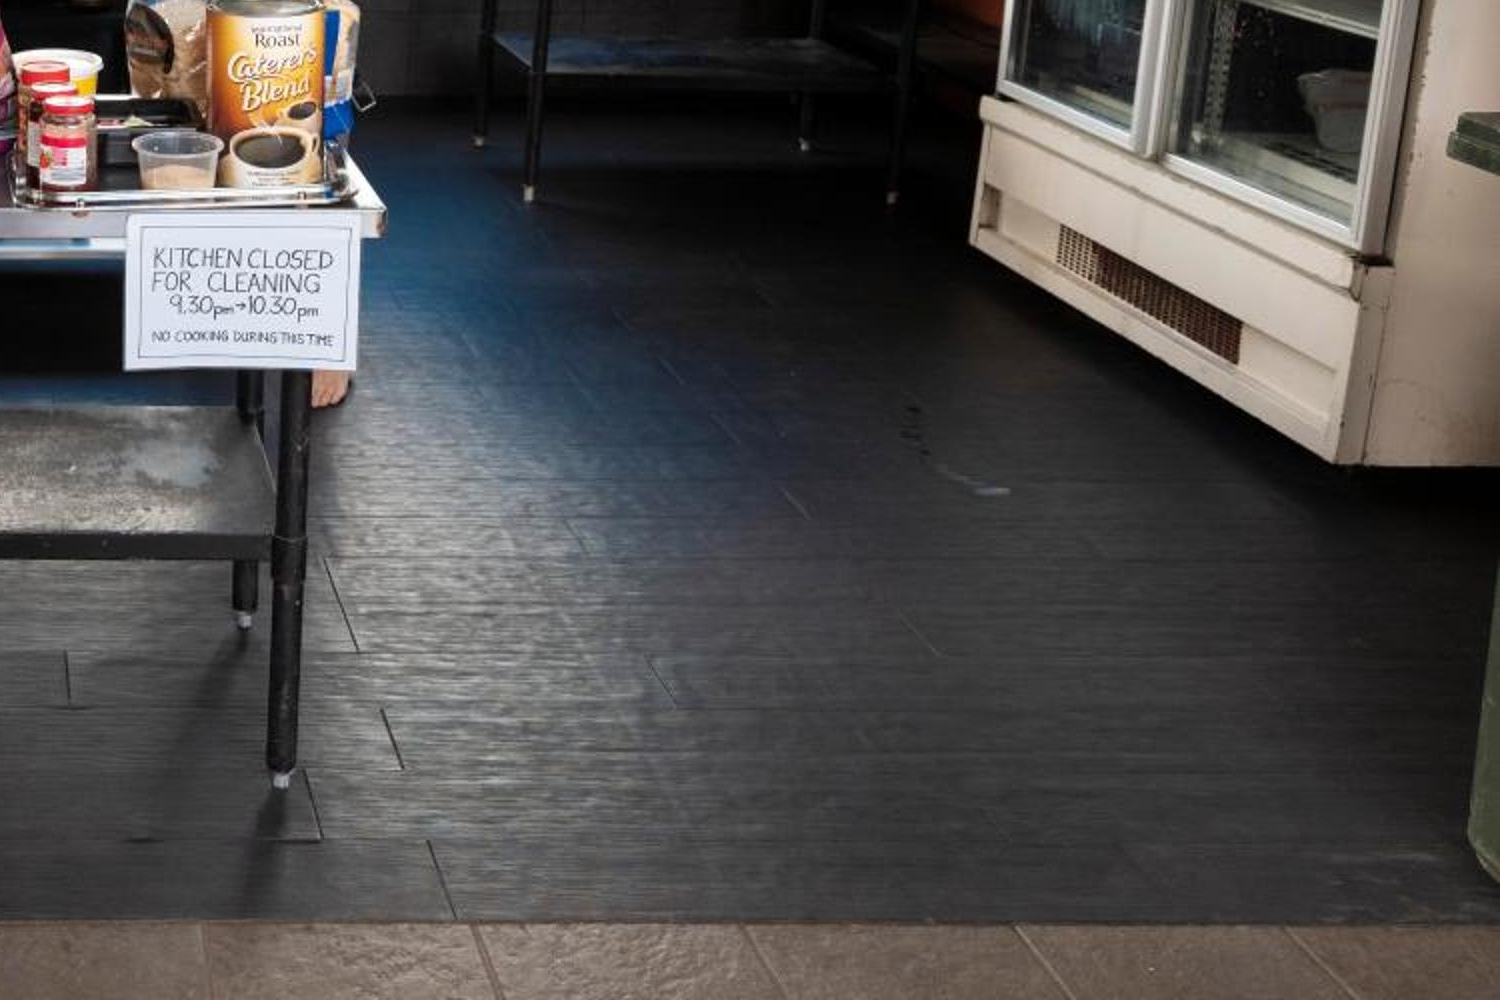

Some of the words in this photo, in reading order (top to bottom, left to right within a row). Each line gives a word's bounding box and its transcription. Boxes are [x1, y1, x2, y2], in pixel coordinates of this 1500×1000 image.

[254, 33, 302, 48] Roast
[240, 72, 310, 112] Blend
[152, 247, 243, 269] KITCHEN
[247, 248, 334, 271] CLOSED
[151, 271, 193, 293] FOR
[207, 271, 321, 294] CLEANING
[151, 330, 171, 343] NO
[174, 330, 229, 344] COOKING
[233, 330, 277, 344] DURING
[279, 331, 305, 345] THIS
[306, 332, 335, 347] TIME
